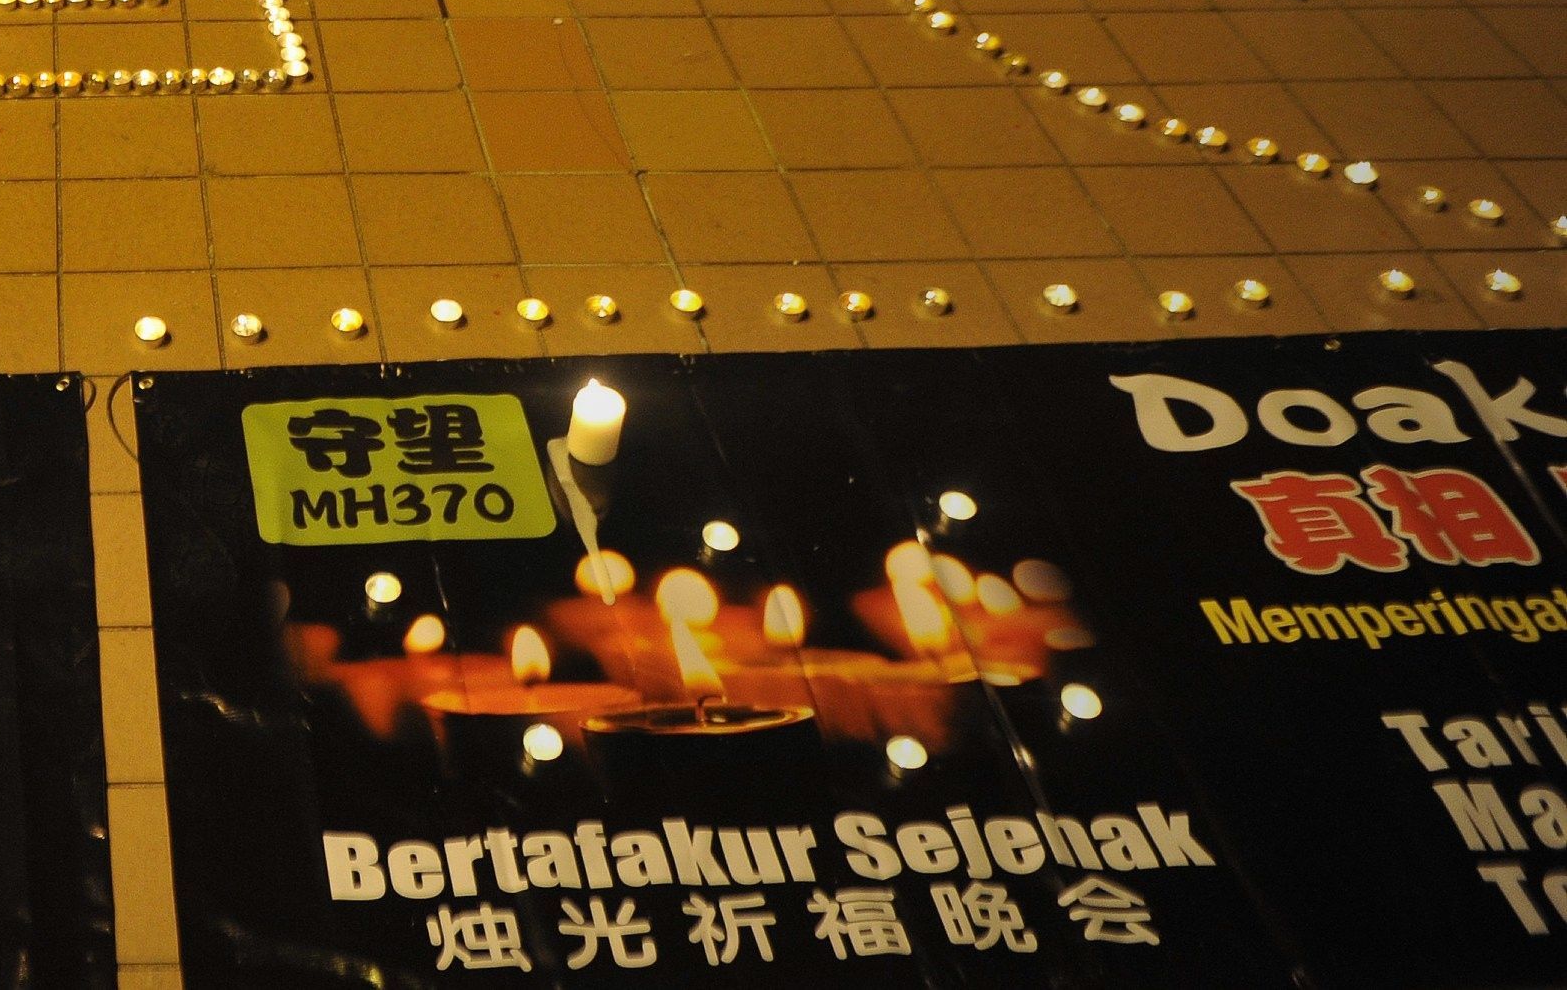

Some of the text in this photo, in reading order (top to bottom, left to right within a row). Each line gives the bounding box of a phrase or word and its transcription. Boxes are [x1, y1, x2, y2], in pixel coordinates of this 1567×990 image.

[286, 402, 496, 479] 守望
[1107, 359, 1567, 454] Doak
[289, 481, 516, 530] MH370
[1228, 462, 1542, 577] 真相
[322, 803, 1216, 902] Bertafakur Sejenak
[427, 876, 1161, 974] 烛光祈福晚会
